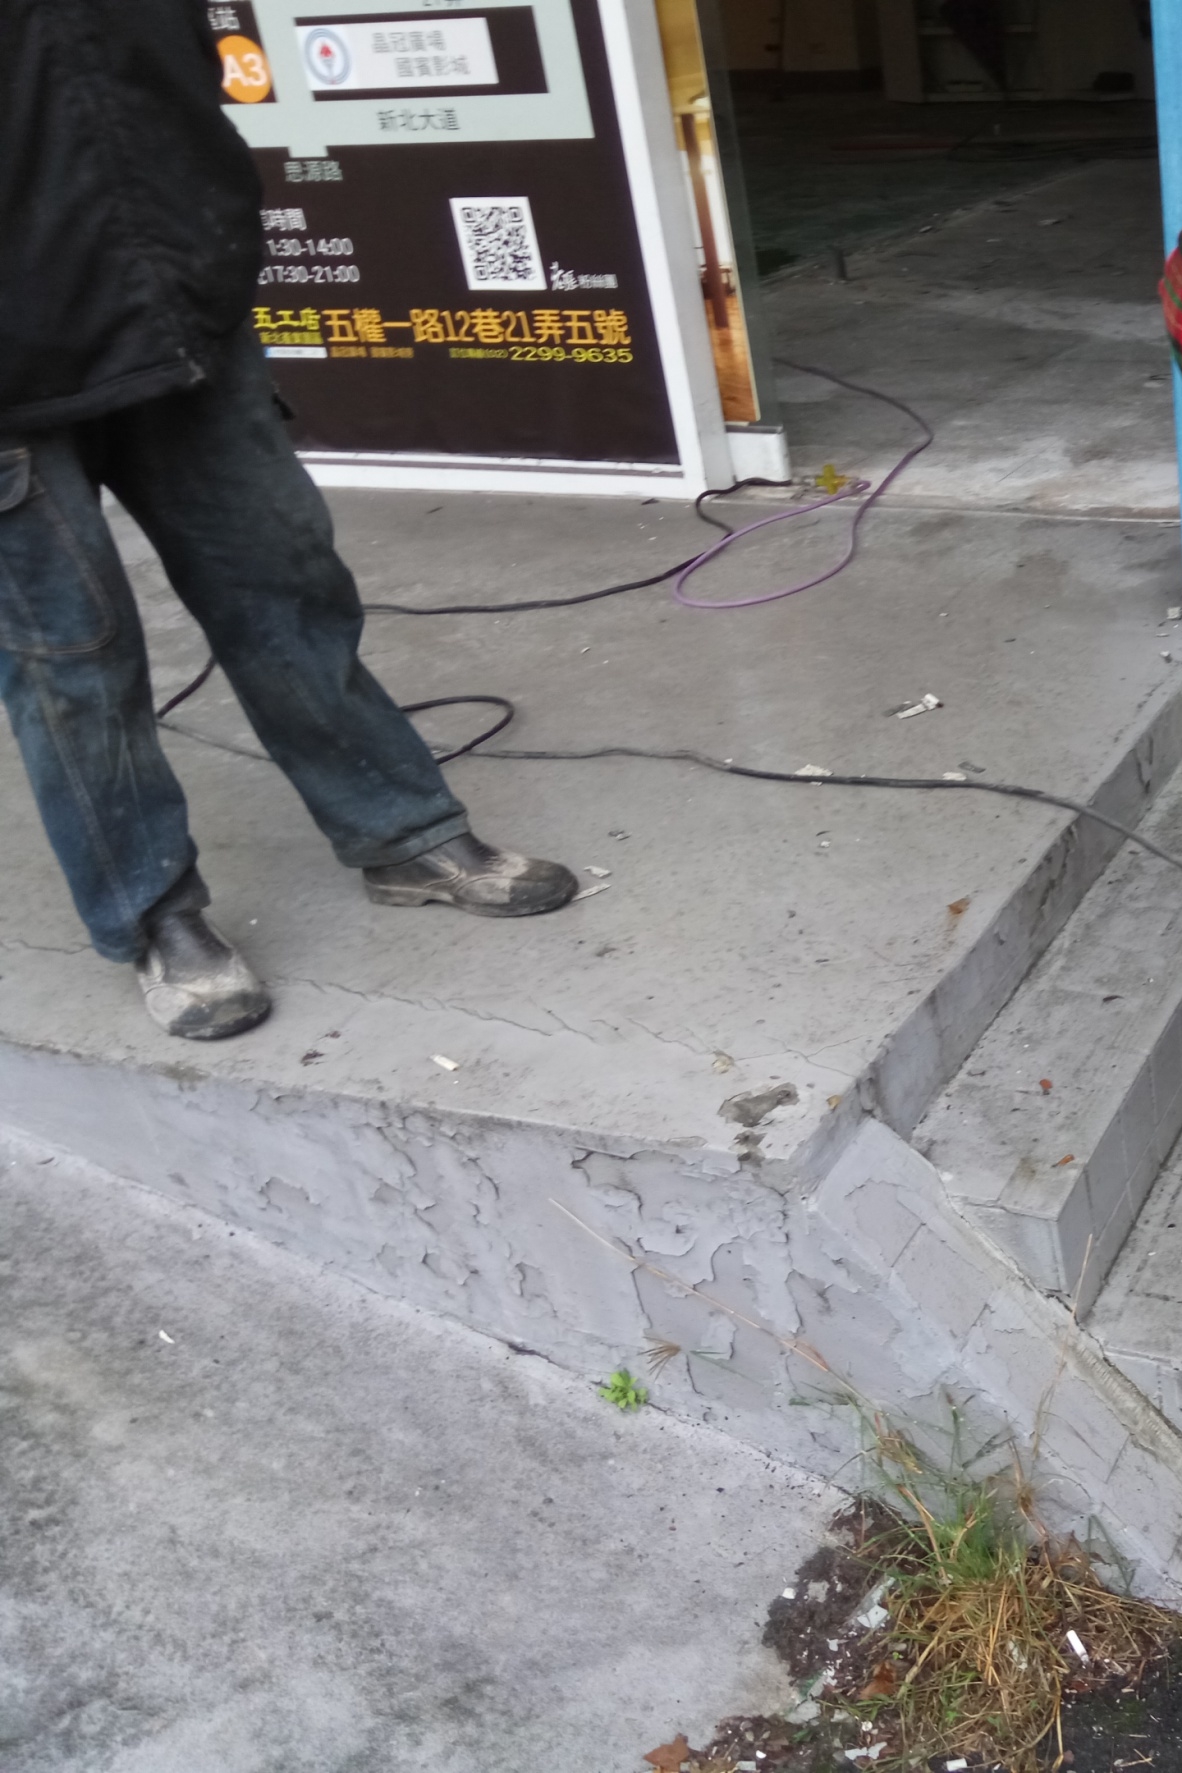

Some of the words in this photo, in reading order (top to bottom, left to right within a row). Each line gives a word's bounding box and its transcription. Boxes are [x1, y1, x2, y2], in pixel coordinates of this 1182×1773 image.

[221, 53, 268, 87] A3
[376, 108, 461, 132] 新北大道
[284, 160, 344, 182] 思源路
[252, 307, 321, 330] 五工店
[509, 346, 634, 363] 2299-9635
